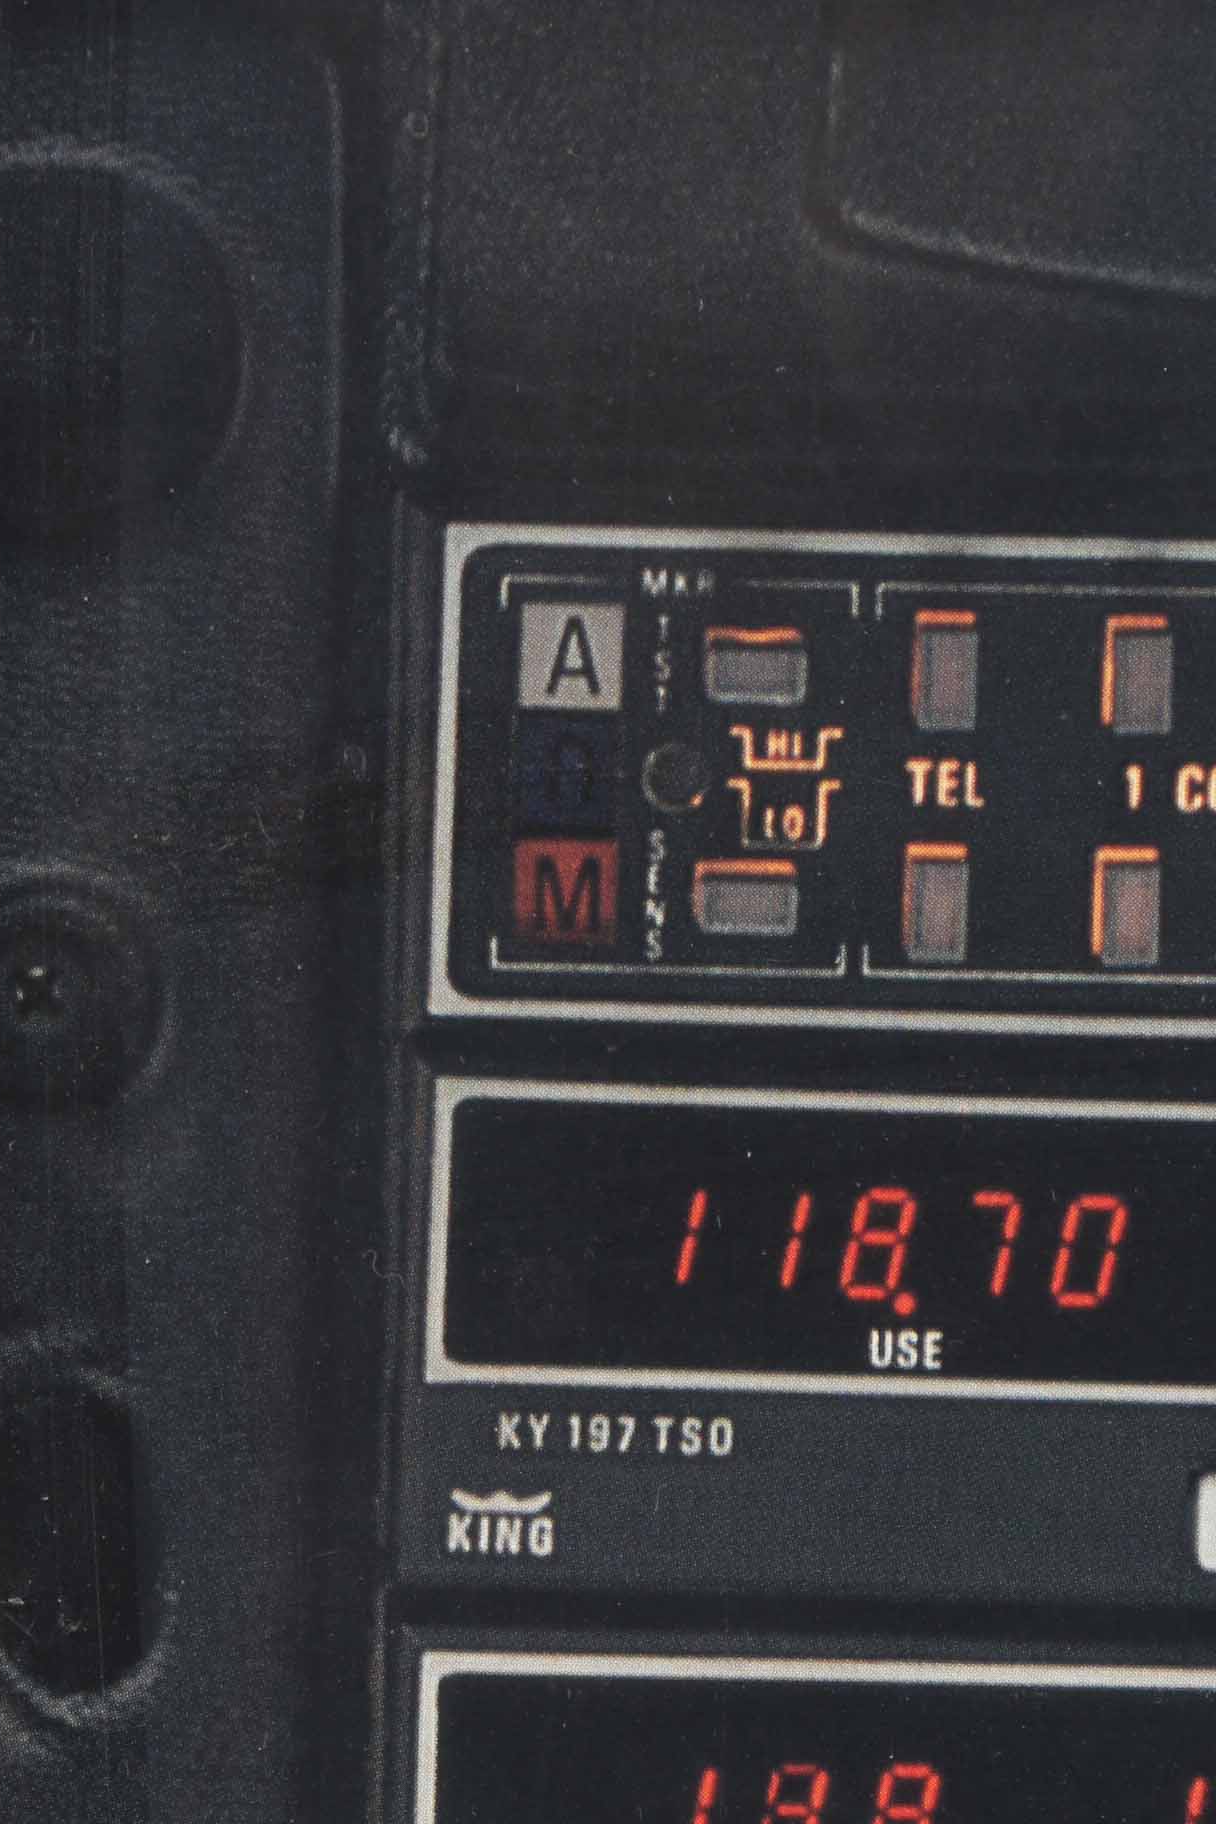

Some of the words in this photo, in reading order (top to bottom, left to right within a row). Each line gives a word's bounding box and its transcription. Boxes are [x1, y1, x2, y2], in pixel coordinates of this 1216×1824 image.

[544, 616, 601, 696] A
[766, 731, 803, 758] HI
[906, 757, 984, 808] TEL
[1125, 764, 1143, 809] 1
[534, 855, 602, 931] M
[645, 830, 665, 959] SENS
[869, 1329, 943, 1370] USE
[498, 1413, 550, 1449] KY
[569, 1414, 636, 1453] 197
[653, 1416, 734, 1457] TSO
[447, 1512, 554, 1557] KING
